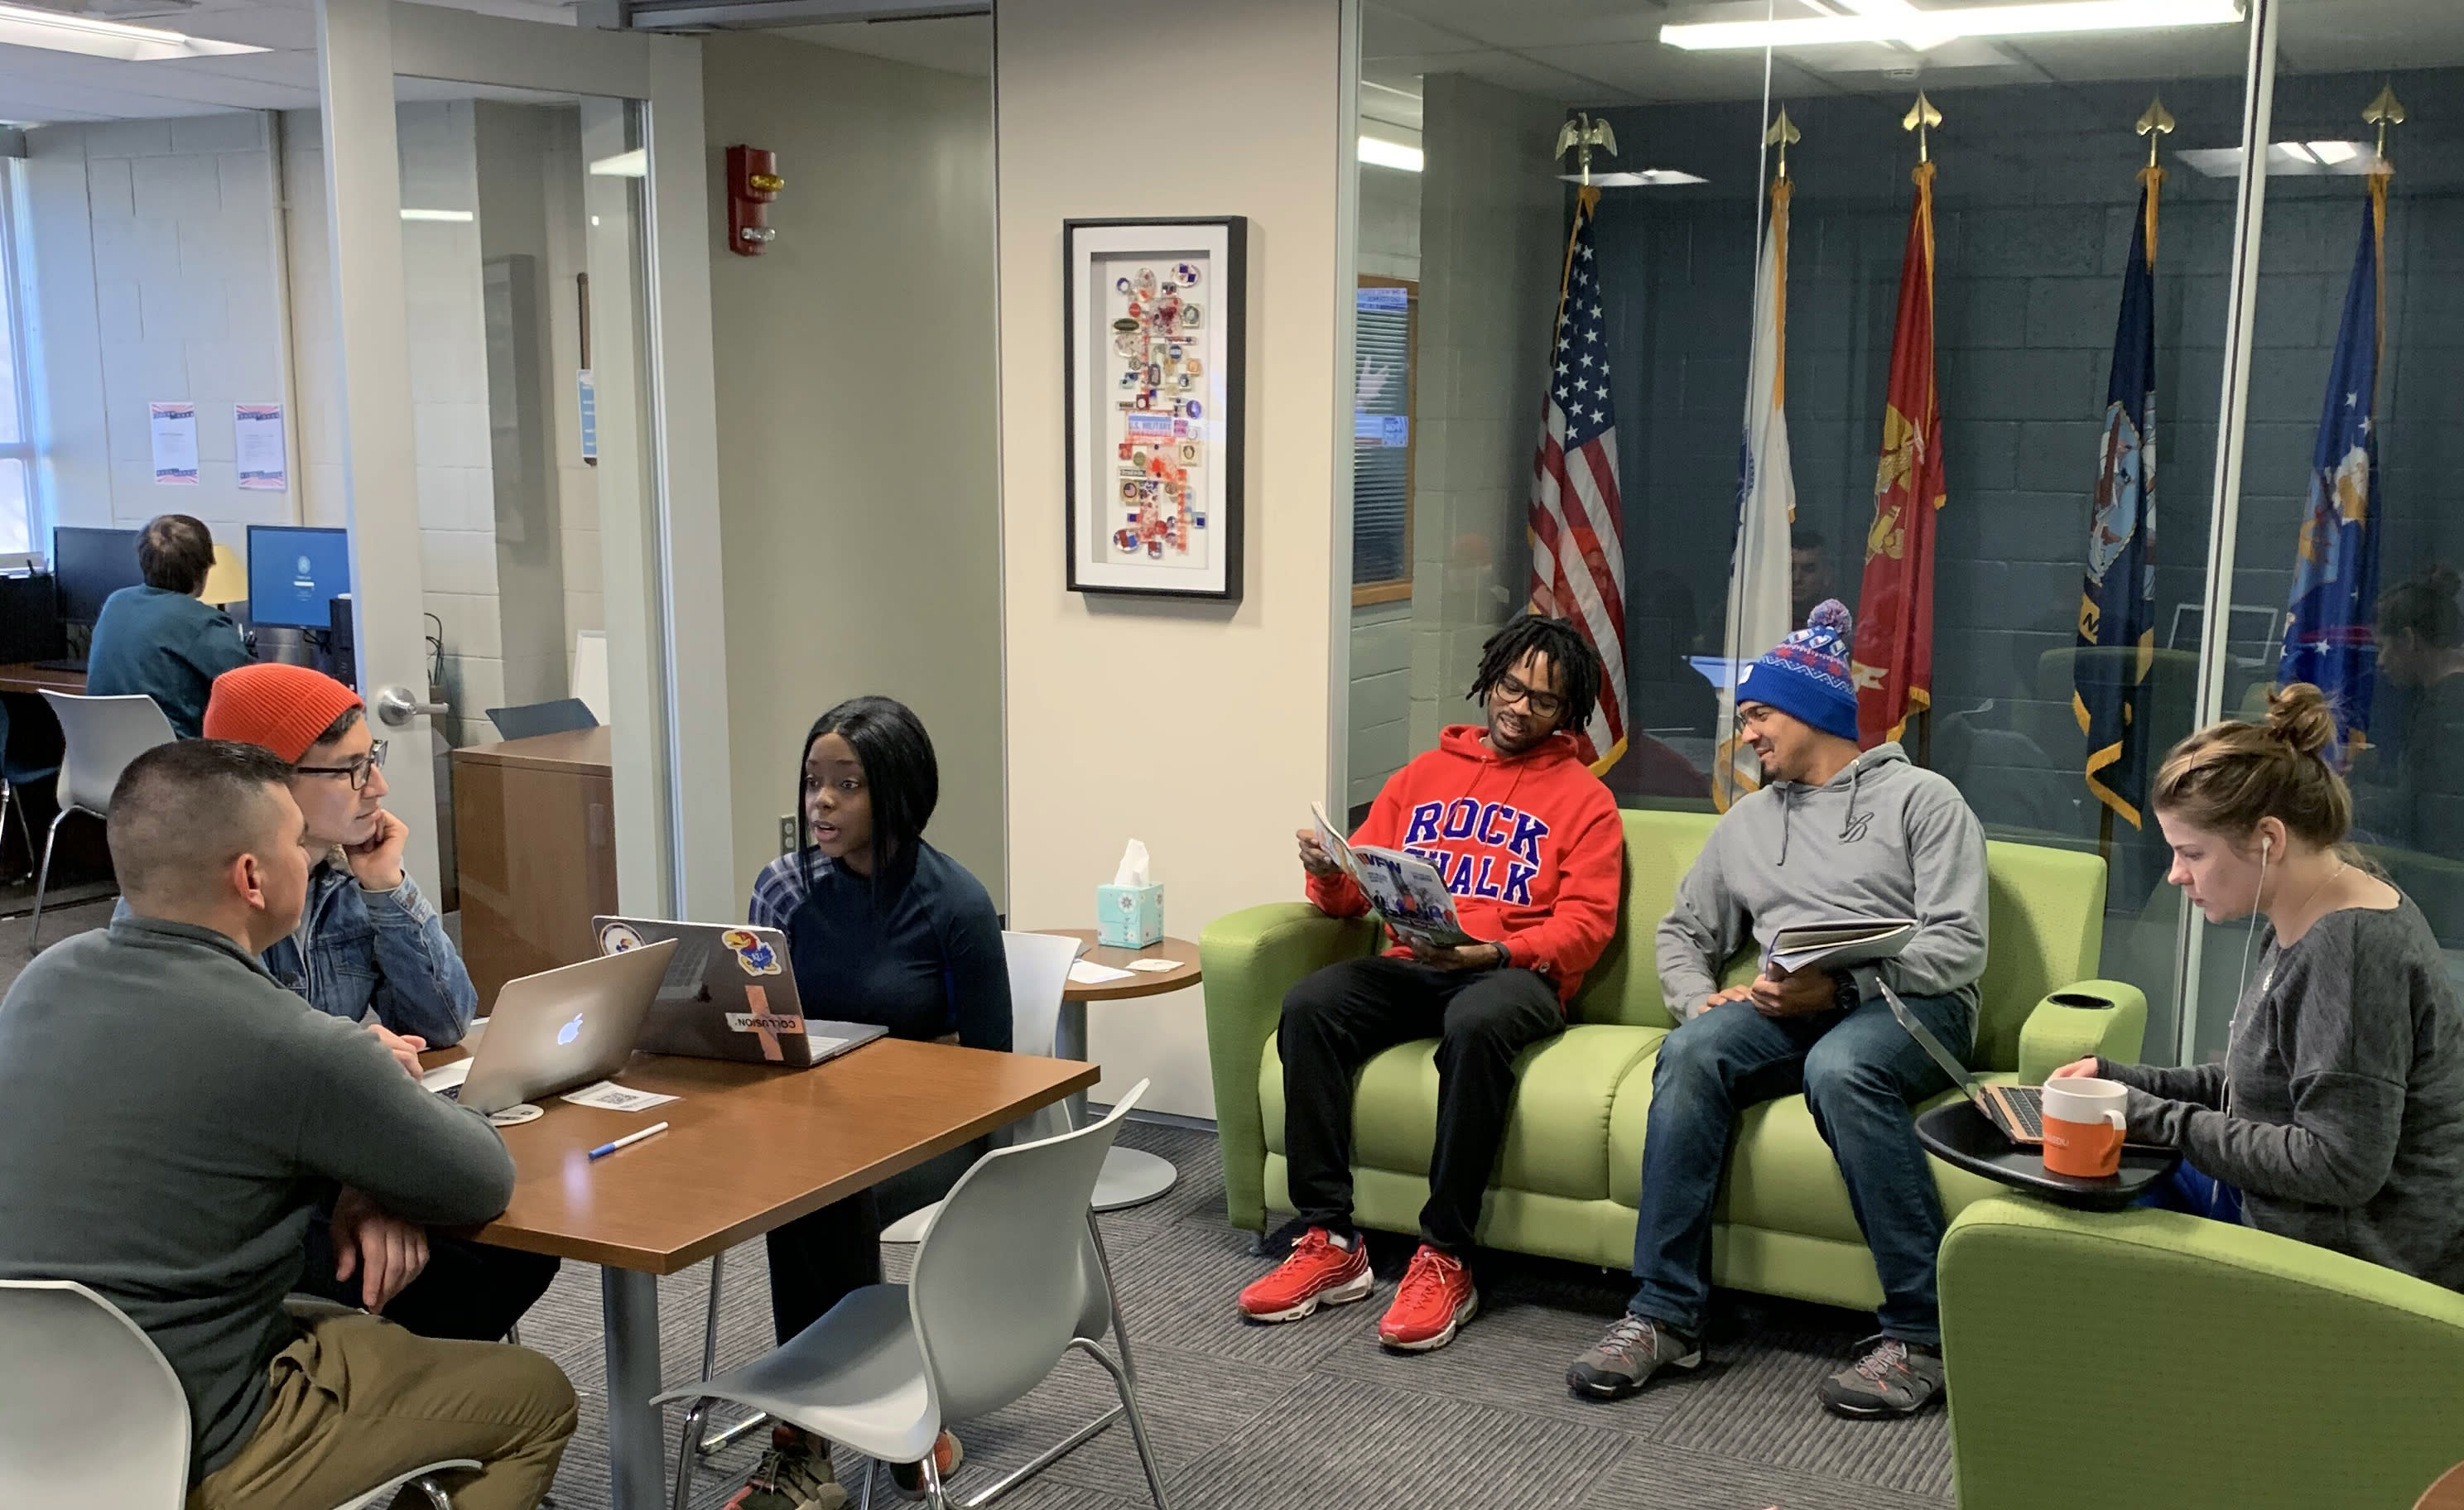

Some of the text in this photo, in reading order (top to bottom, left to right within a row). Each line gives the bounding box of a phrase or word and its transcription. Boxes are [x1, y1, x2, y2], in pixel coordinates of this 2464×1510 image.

[1403, 797, 1550, 870] ROCK
[1369, 853, 1402, 874] VFW
[1401, 845, 1538, 908] HALK
[736, 1018, 796, 1029] COLLUSION
